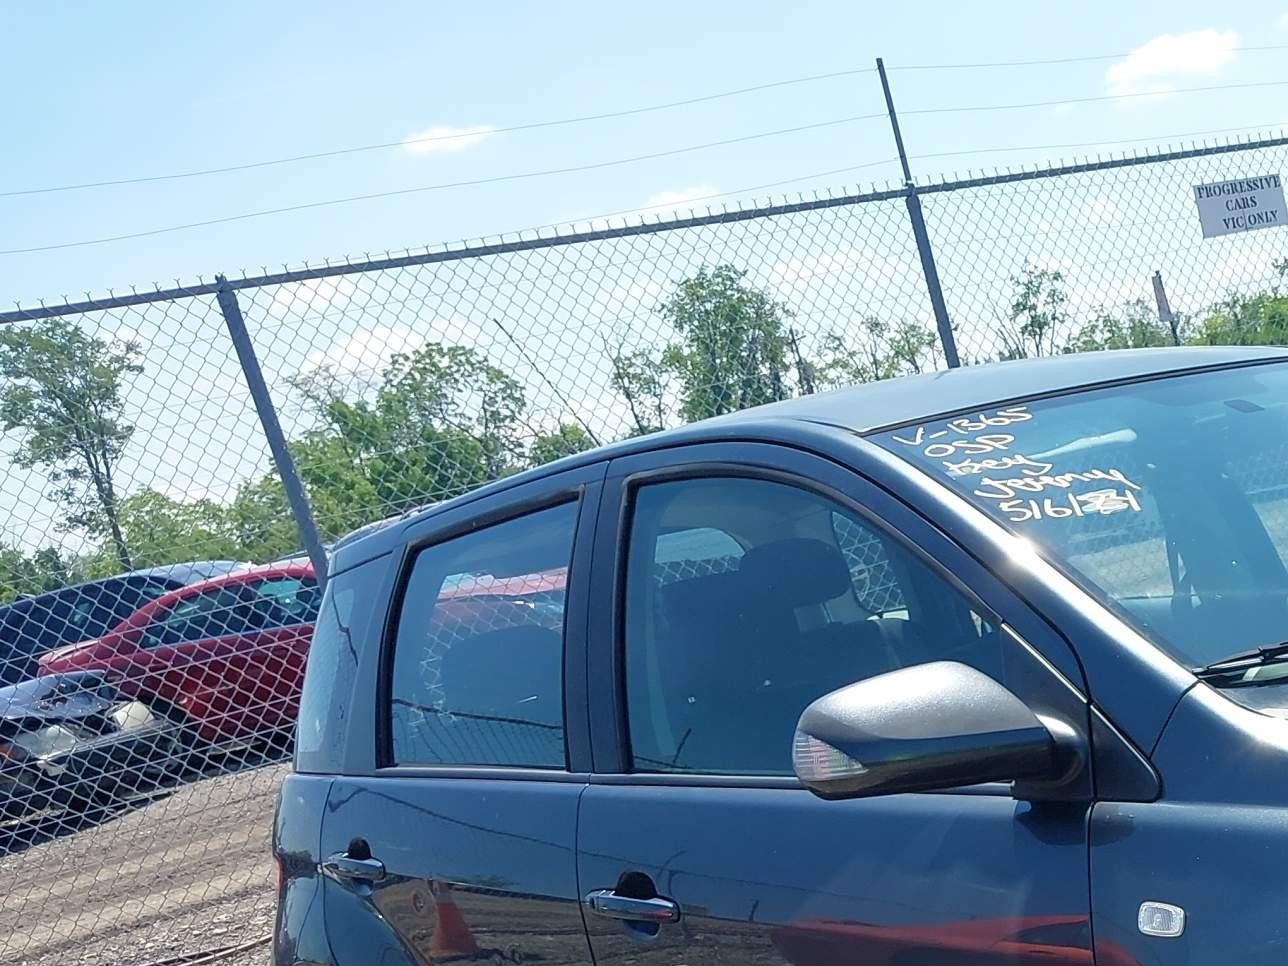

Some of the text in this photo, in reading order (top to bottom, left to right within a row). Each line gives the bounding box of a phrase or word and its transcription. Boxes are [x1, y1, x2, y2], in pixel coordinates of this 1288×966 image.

[1196, 175, 1281, 199] PROGRESSIVE
[1225, 195, 1258, 212] CARS
[1247, 210, 1278, 226] ONLY
[924, 434, 1015, 457] OSP
